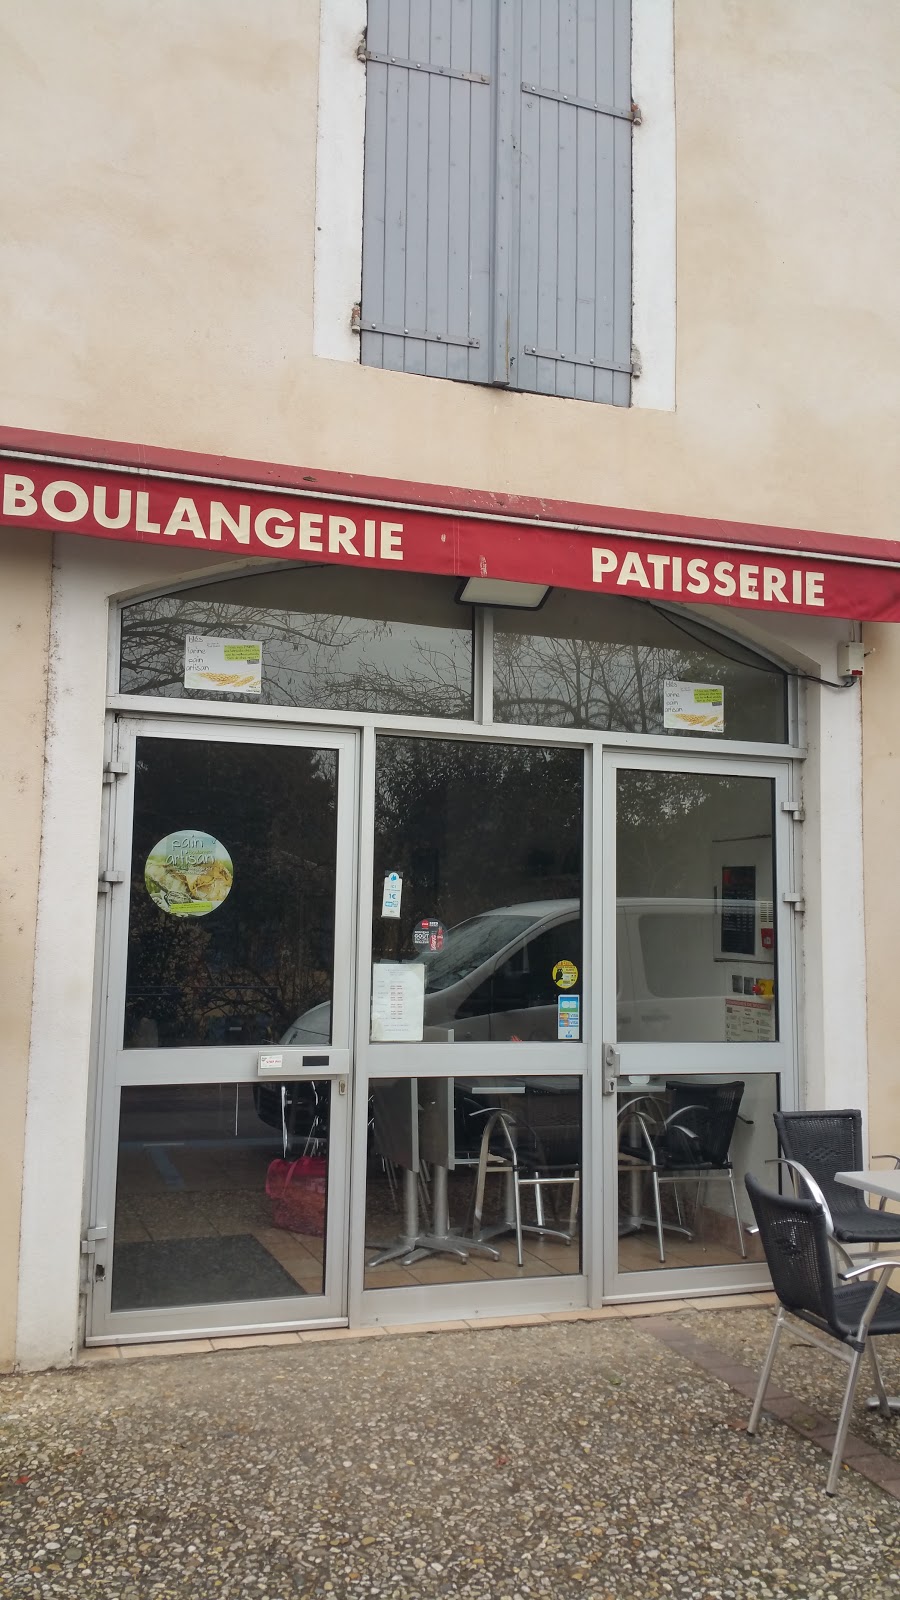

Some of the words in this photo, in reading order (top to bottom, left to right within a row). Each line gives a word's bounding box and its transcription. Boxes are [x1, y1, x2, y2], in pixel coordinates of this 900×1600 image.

[2, 474, 404, 561] BOULANGERIE
[591, 547, 825, 607] PATISSERIE
[165, 849, 215, 865] artisan
[171, 834, 204, 851] pain
